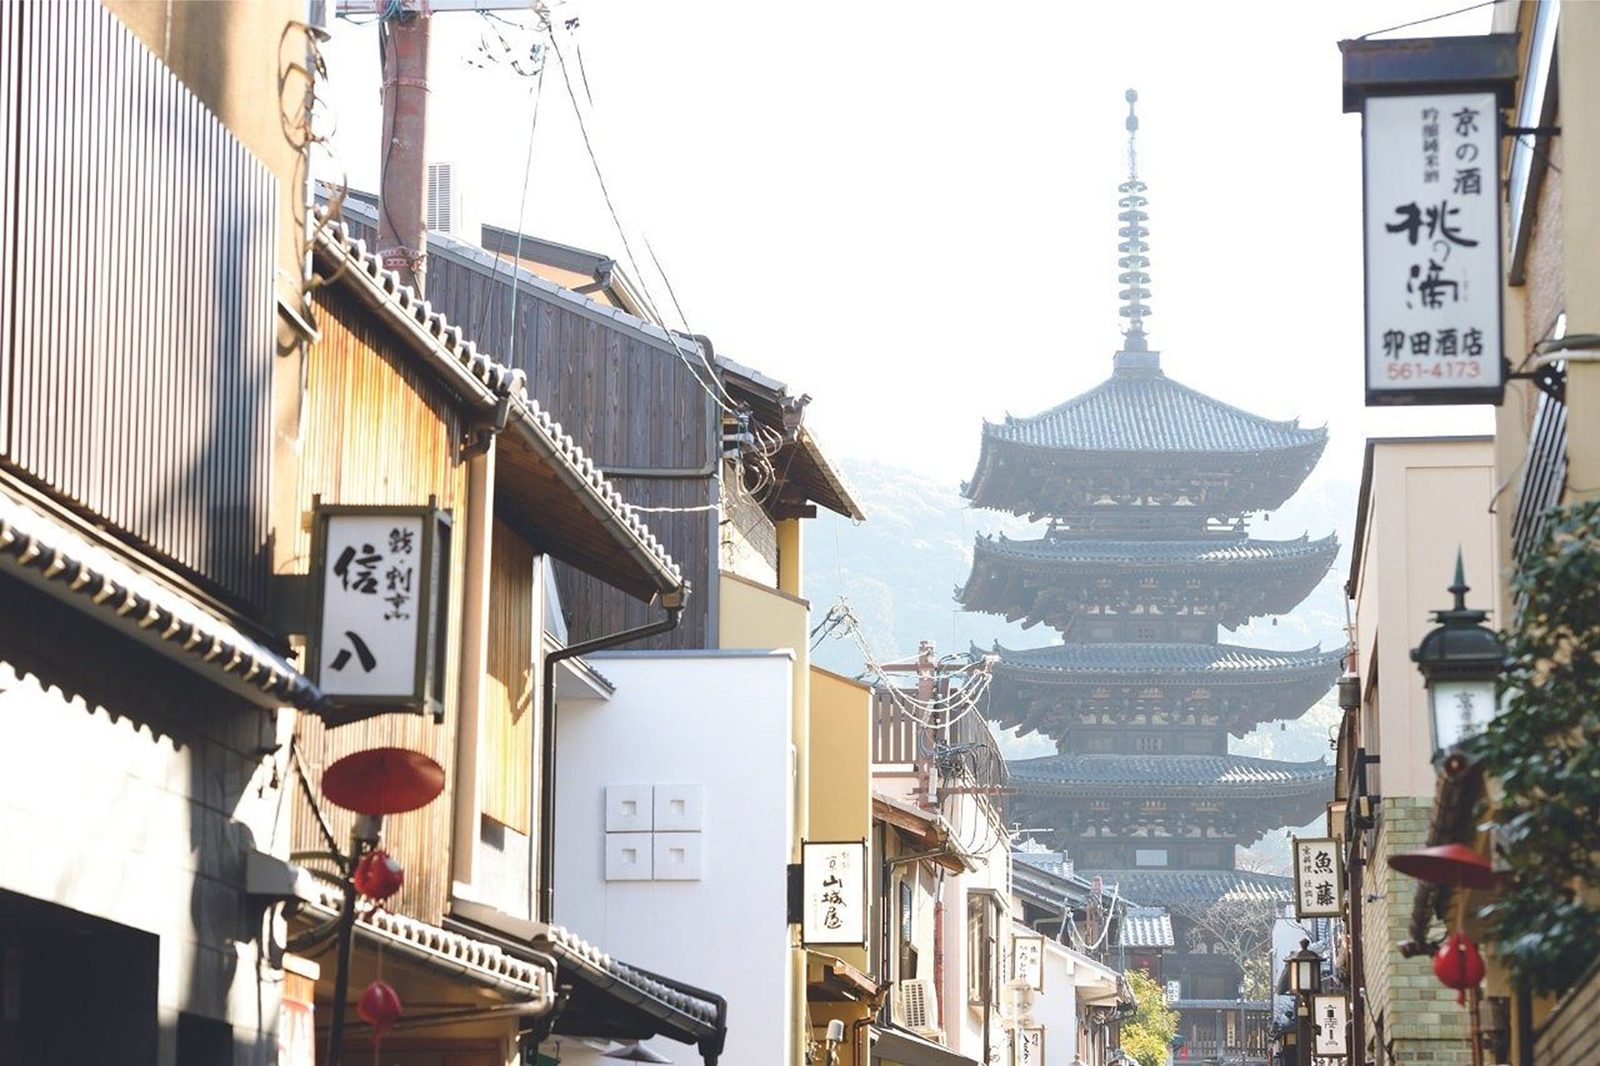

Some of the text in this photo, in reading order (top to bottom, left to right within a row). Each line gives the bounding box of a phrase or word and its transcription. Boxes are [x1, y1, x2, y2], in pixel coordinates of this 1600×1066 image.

[1452, 107, 1481, 195] 京の酒
[1387, 361, 1481, 379] 561-4173
[329, 544, 383, 673] 信八
[1313, 850, 1335, 906] 魚藤
